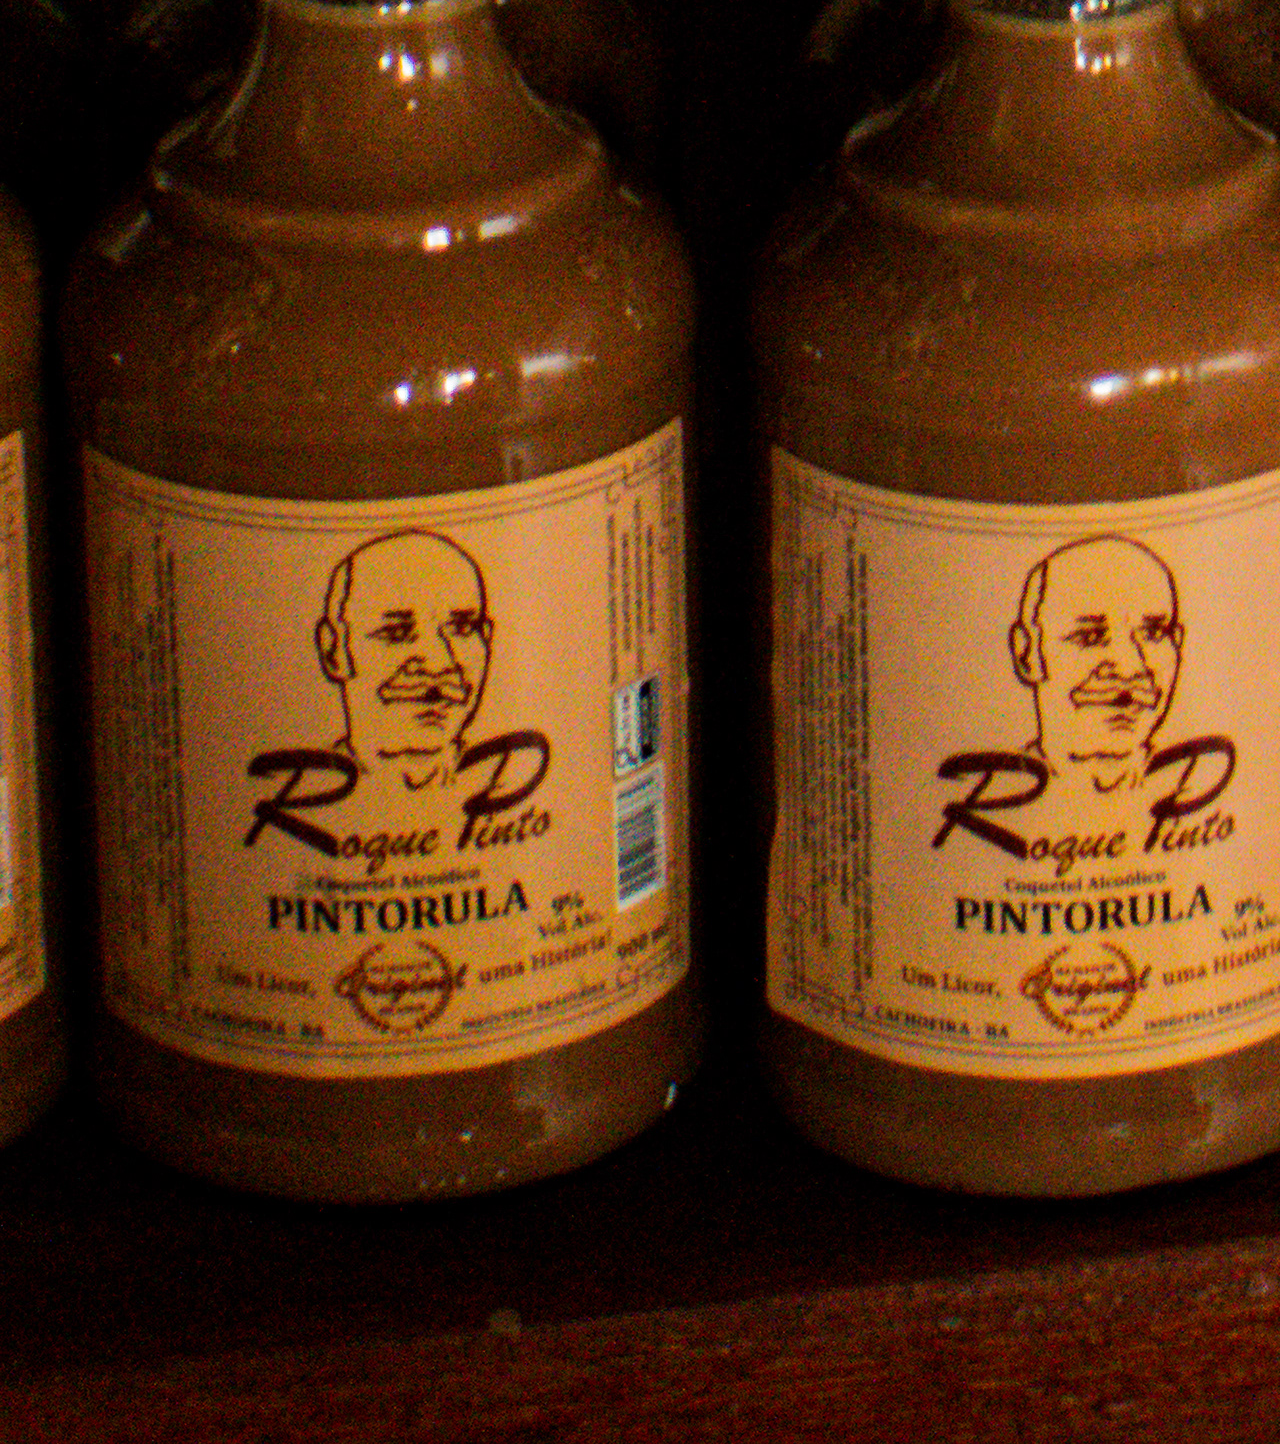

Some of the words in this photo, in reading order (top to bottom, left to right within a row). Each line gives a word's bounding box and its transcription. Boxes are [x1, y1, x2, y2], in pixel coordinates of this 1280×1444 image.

[244, 748, 439, 872] Roque
[456, 729, 552, 851] Pinto
[931, 751, 1127, 876] Roque
[1143, 735, 1236, 853] Pinto
[267, 880, 529, 933] PINTORULA
[955, 884, 1212, 936] PINTORULA
[479, 963, 525, 983] uma
[902, 966, 936, 989] Um
[943, 973, 1000, 998] Licor,
[1162, 965, 1207, 986] uma
